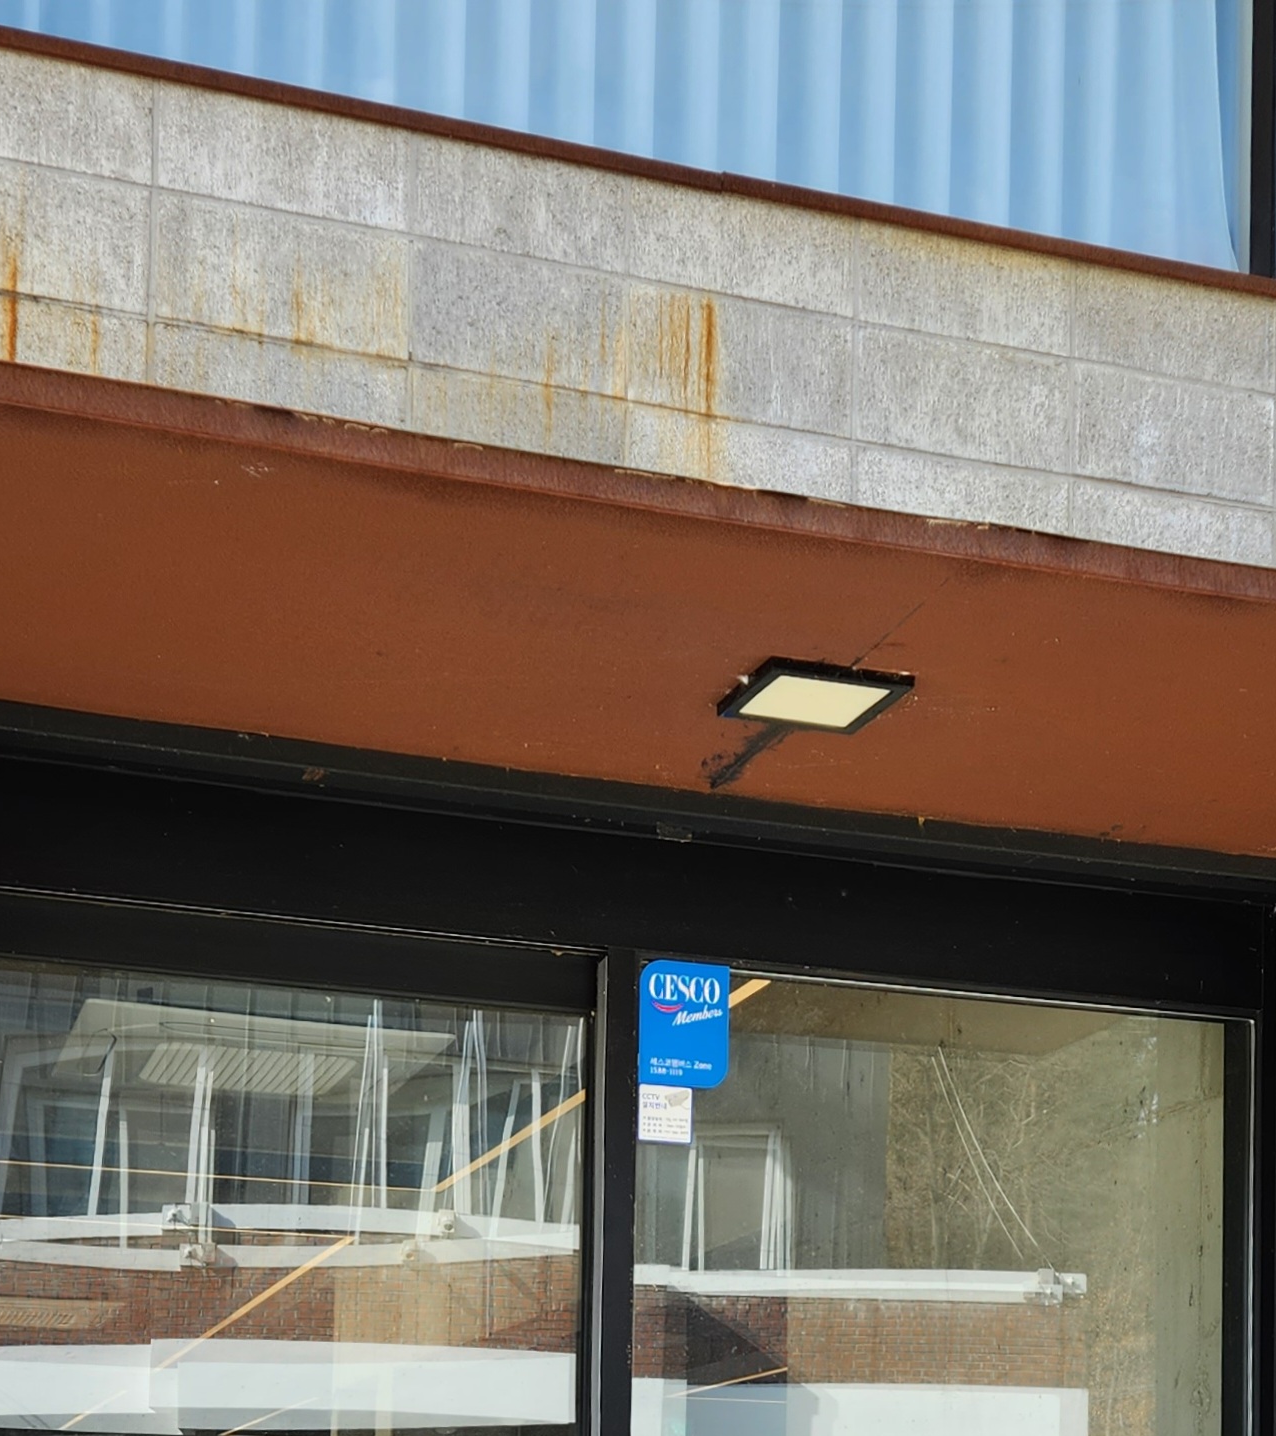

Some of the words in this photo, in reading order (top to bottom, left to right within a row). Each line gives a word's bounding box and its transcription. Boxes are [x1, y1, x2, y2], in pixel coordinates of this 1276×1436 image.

[648, 972, 721, 1004] CESCO
[672, 1005, 723, 1026] Members
[693, 1060, 713, 1071] Zone
[642, 1092, 660, 1100] CCTV
